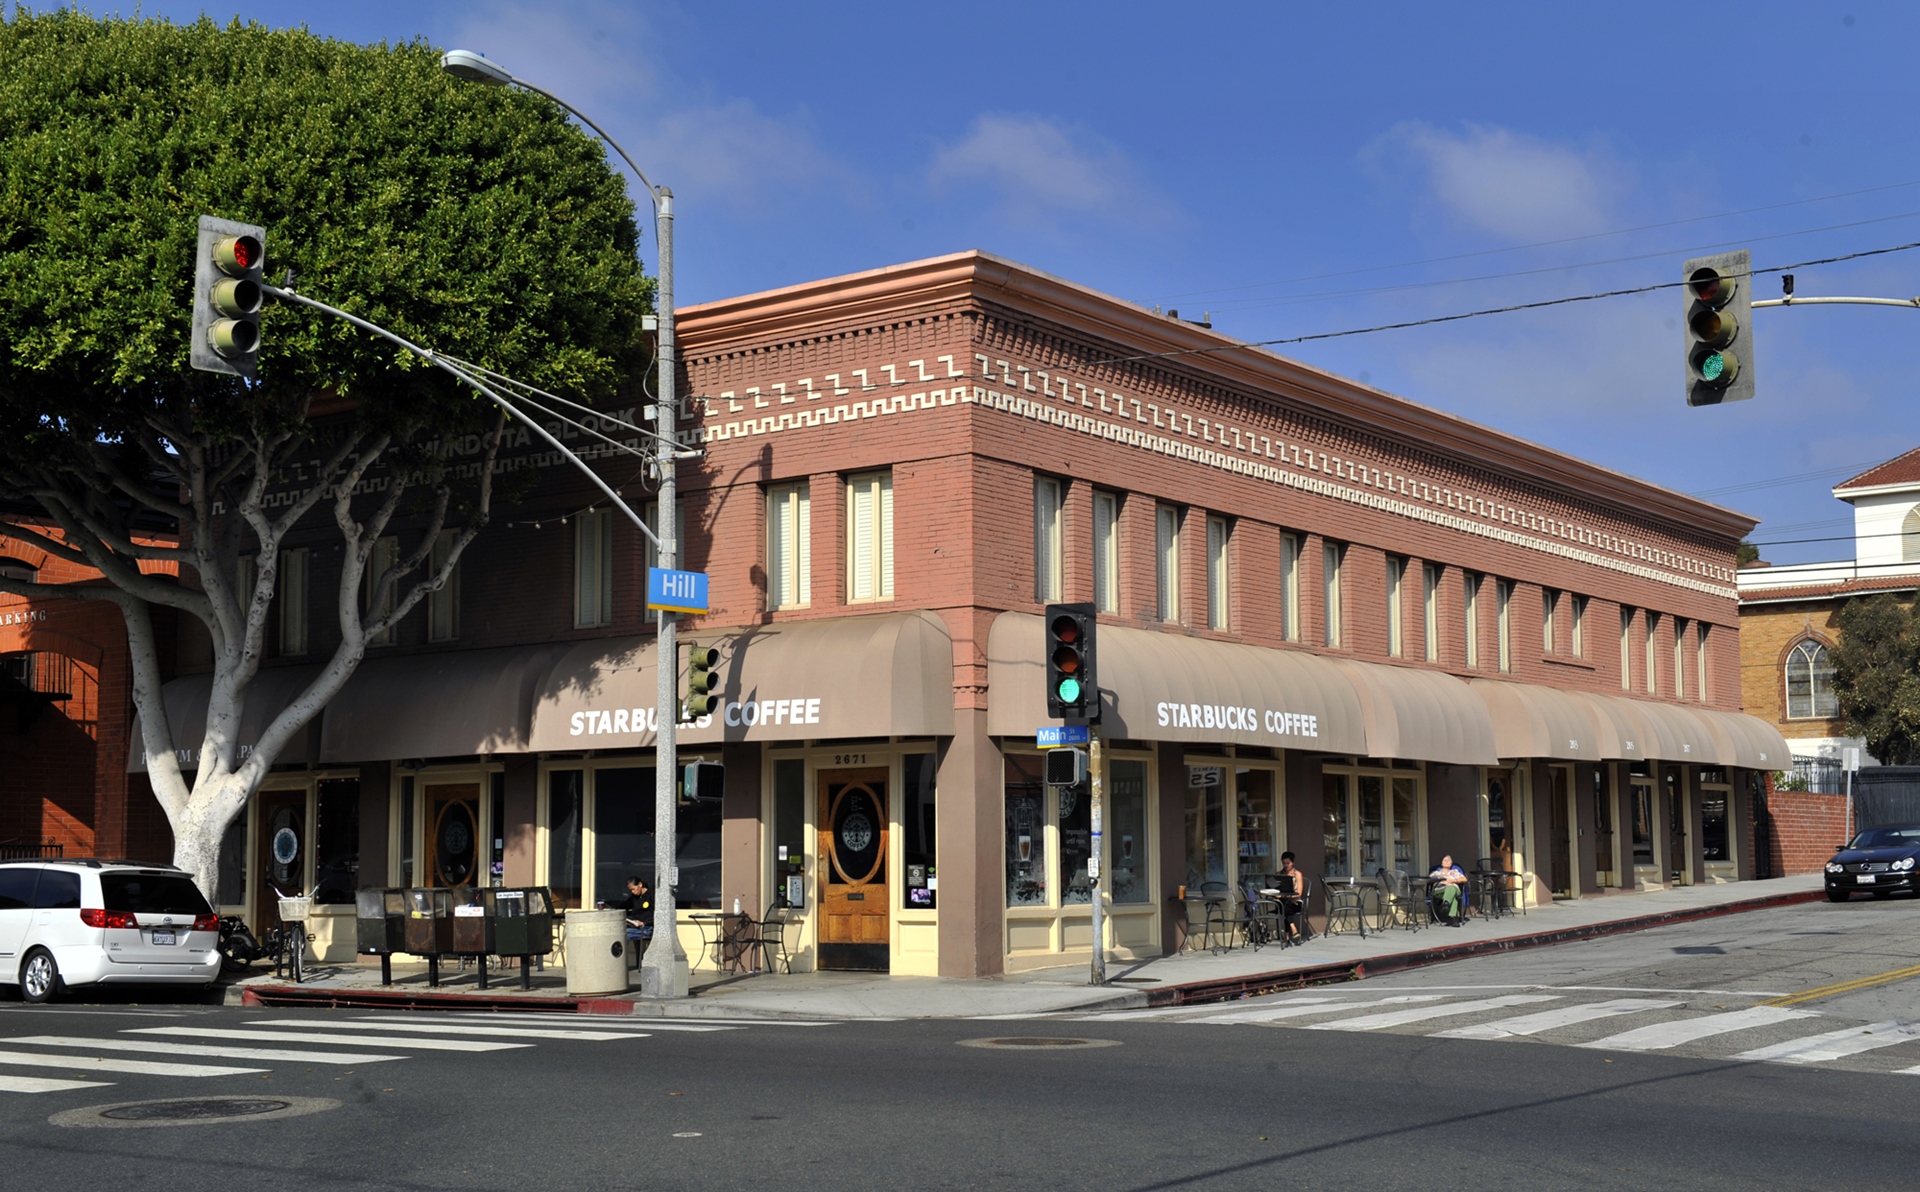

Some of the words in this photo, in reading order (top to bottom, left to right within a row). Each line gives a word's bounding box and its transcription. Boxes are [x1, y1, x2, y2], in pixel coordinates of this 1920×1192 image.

[544, 407, 636, 441] BLOCK
[662, 573, 695, 599] Hill
[724, 698, 821, 727] COFFEE
[1157, 701, 1257, 732] STARBUCKS
[1264, 710, 1318, 738] COFFEE
[1039, 729, 1066, 742] Main
[835, 754, 866, 764] 2671
[844, 815, 869, 830] STARBUCKS
[847, 839, 866, 848] COFFEE
